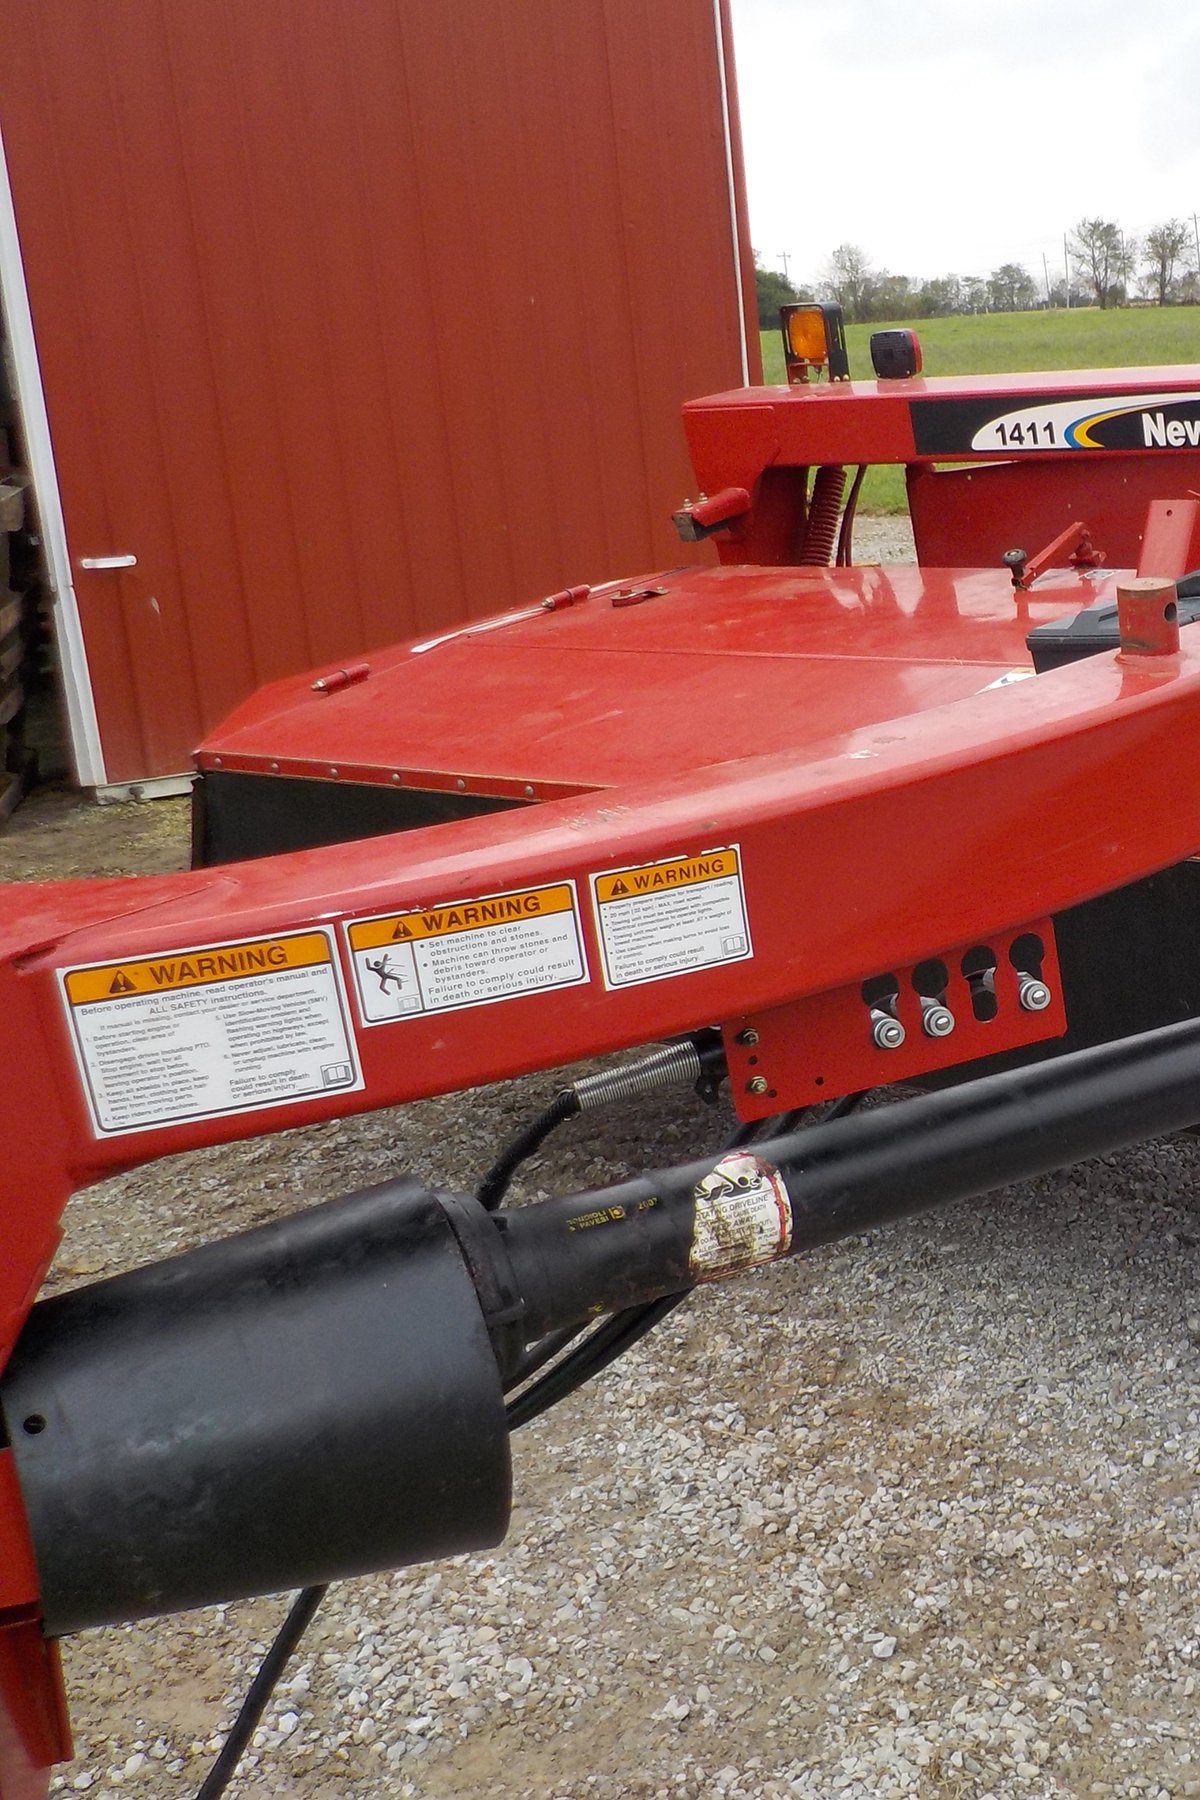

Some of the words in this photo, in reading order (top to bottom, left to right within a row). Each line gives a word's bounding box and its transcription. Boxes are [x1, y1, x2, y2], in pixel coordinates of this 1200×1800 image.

[995, 421, 1057, 447] 1411
[633, 859, 724, 889] WARNING
[421, 895, 540, 931] WARNING
[428, 940, 443, 948] Set
[446, 933, 484, 944] machine
[499, 926, 520, 934] clear
[430, 941, 488, 957] obstructions
[490, 935, 507, 945] and
[431, 954, 469, 966] Machine
[472, 950, 489, 958] can
[491, 945, 516, 955] throw
[519, 938, 549, 949] stones
[552, 933, 568, 942] and
[148, 945, 287, 984] WARNING
[433, 964, 462, 975] debris
[464, 957, 496, 969] toward
[498, 949, 536, 962] operator
[428, 983, 463, 995] Failure
[479, 972, 514, 985] comply
[517, 965, 544, 977] could
[547, 959, 574, 970] result
[80, 1005, 112, 1016] Before
[114, 997, 159, 1010] operating
[205, 985, 226, 994] read
[227, 978, 274, 991] operator's
[276, 971, 309, 982] manual
[311, 967, 327, 976] and
[442, 990, 470, 1001] death
[486, 980, 523, 992] serious
[149, 1005, 168, 1014] ALL
[169, 998, 207, 1011] SAFETY
[229, 1077, 256, 1085] Failure
[267, 1069, 296, 1079] comply
[230, 1083, 253, 1092] could
[254, 1079, 277, 1087] result
[288, 1073, 309, 1081] death
[243, 1087, 272, 1097] serious
